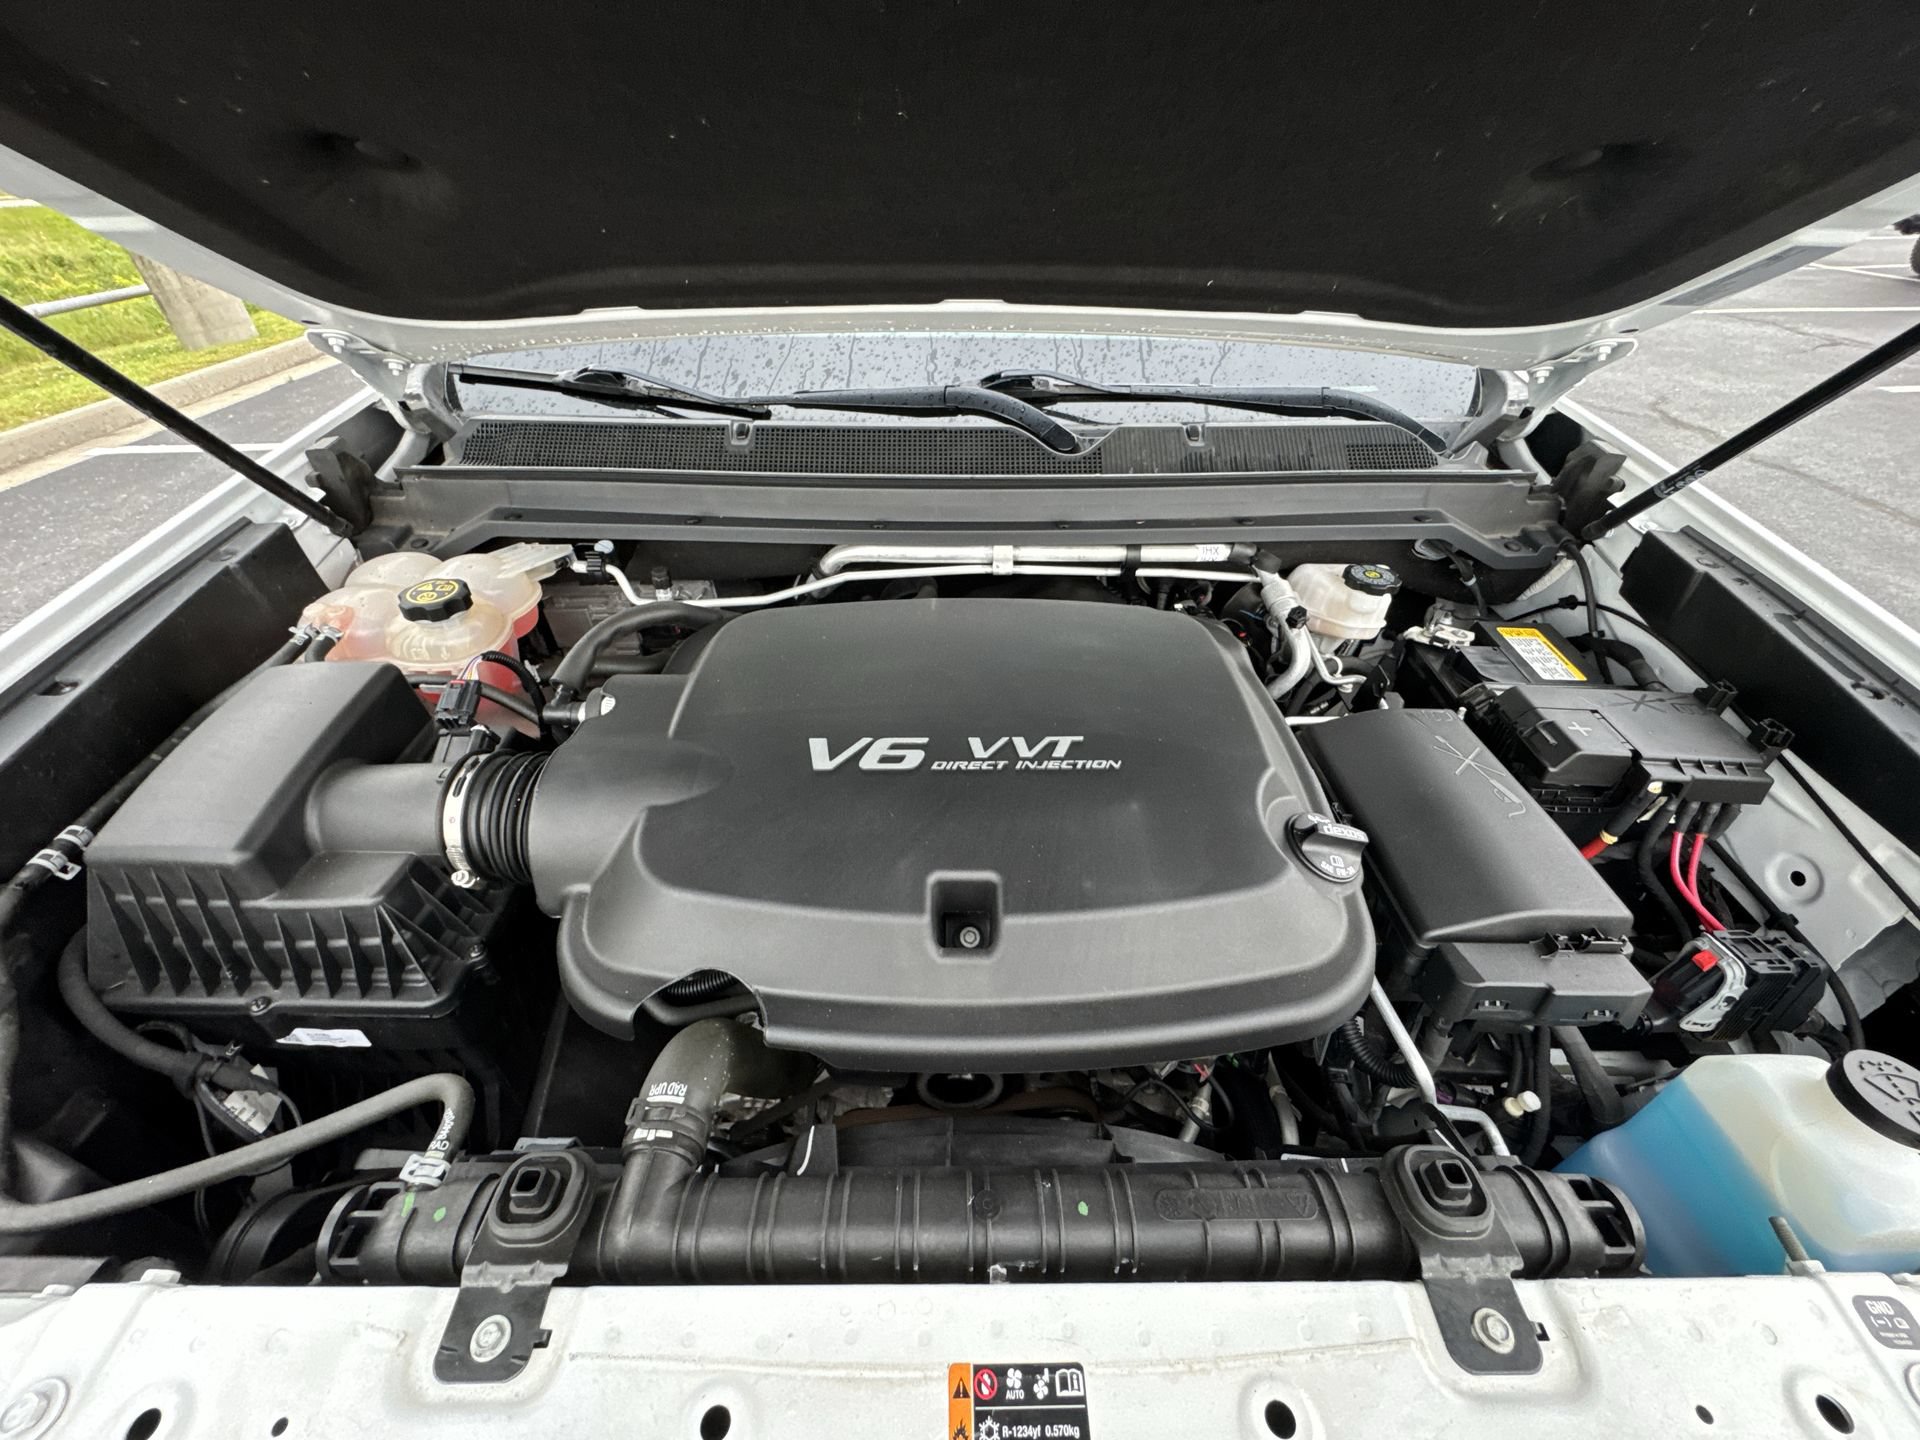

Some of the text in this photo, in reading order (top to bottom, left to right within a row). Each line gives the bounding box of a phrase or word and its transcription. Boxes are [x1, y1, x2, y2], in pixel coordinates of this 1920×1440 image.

[808, 736, 1084, 771] V6 VVT
[931, 760, 1122, 770] DIRECT INJECTION
[648, 1081, 688, 1097] RAD UPR
[430, 1140, 449, 1151] RAD
[1865, 1300, 1895, 1315] GND
[1006, 1389, 1025, 1400] AUTO
[1002, 1424, 1080, 1439] R-1234yf 0.570kg
